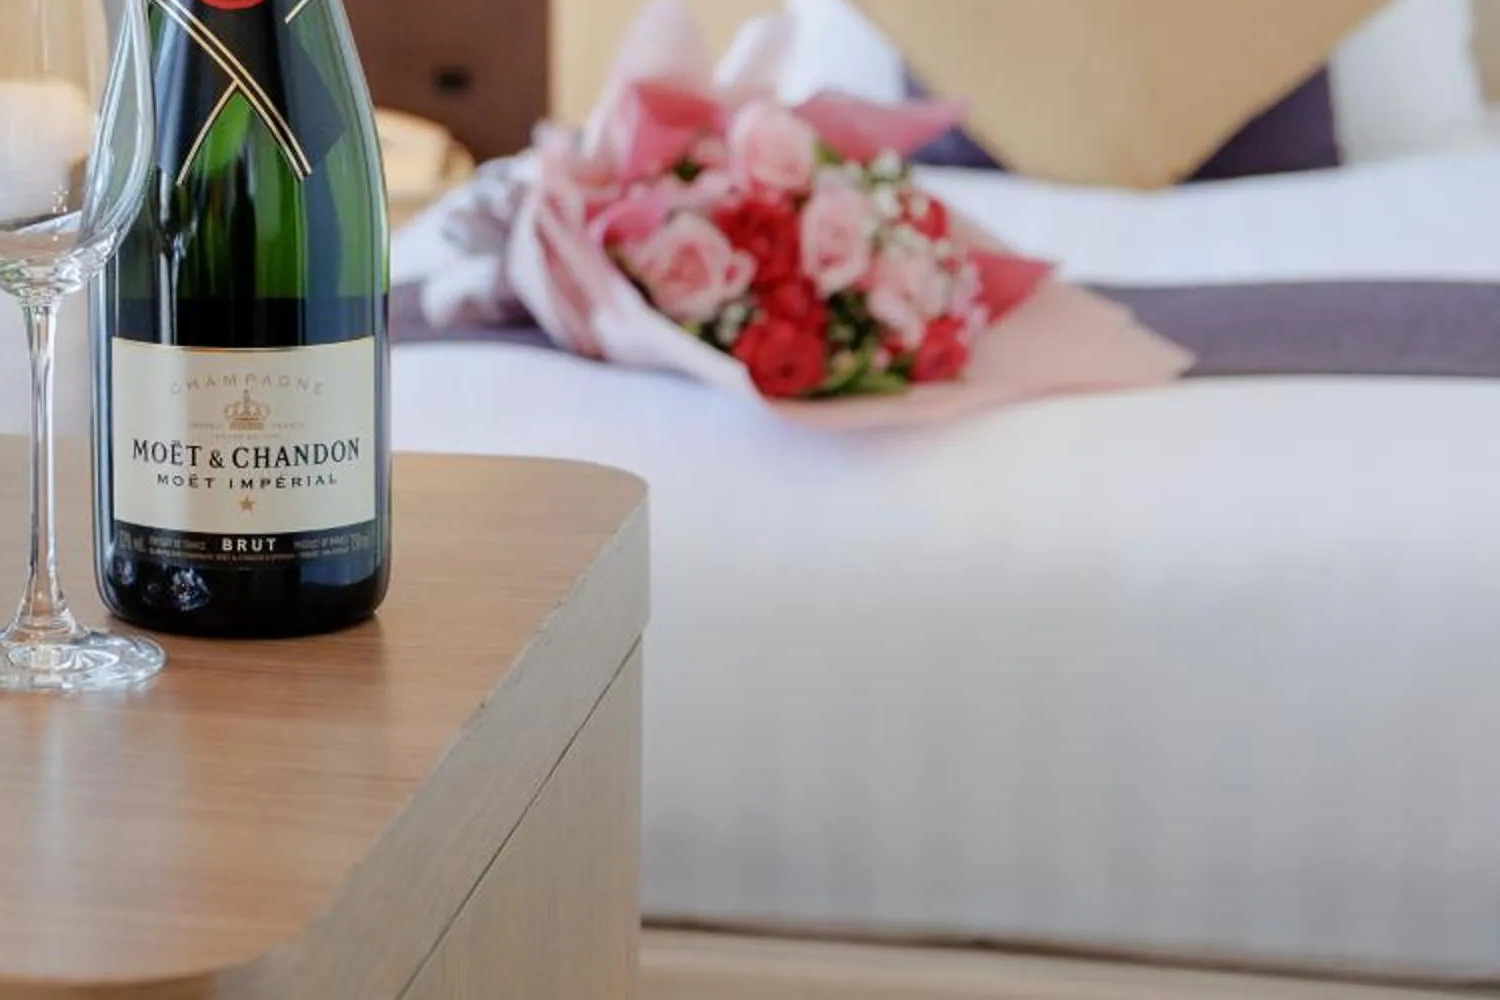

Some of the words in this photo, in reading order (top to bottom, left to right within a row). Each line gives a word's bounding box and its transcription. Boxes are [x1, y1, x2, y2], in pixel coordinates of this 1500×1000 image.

[170, 373, 325, 396] CHAMPAGNE
[132, 437, 202, 467] MOËT
[209, 450, 225, 469] &
[232, 437, 360, 469] CHANDON
[157, 473, 216, 488] MOËT
[229, 473, 337, 489] IMPÉRIAL
[222, 538, 276, 551] BRUT
